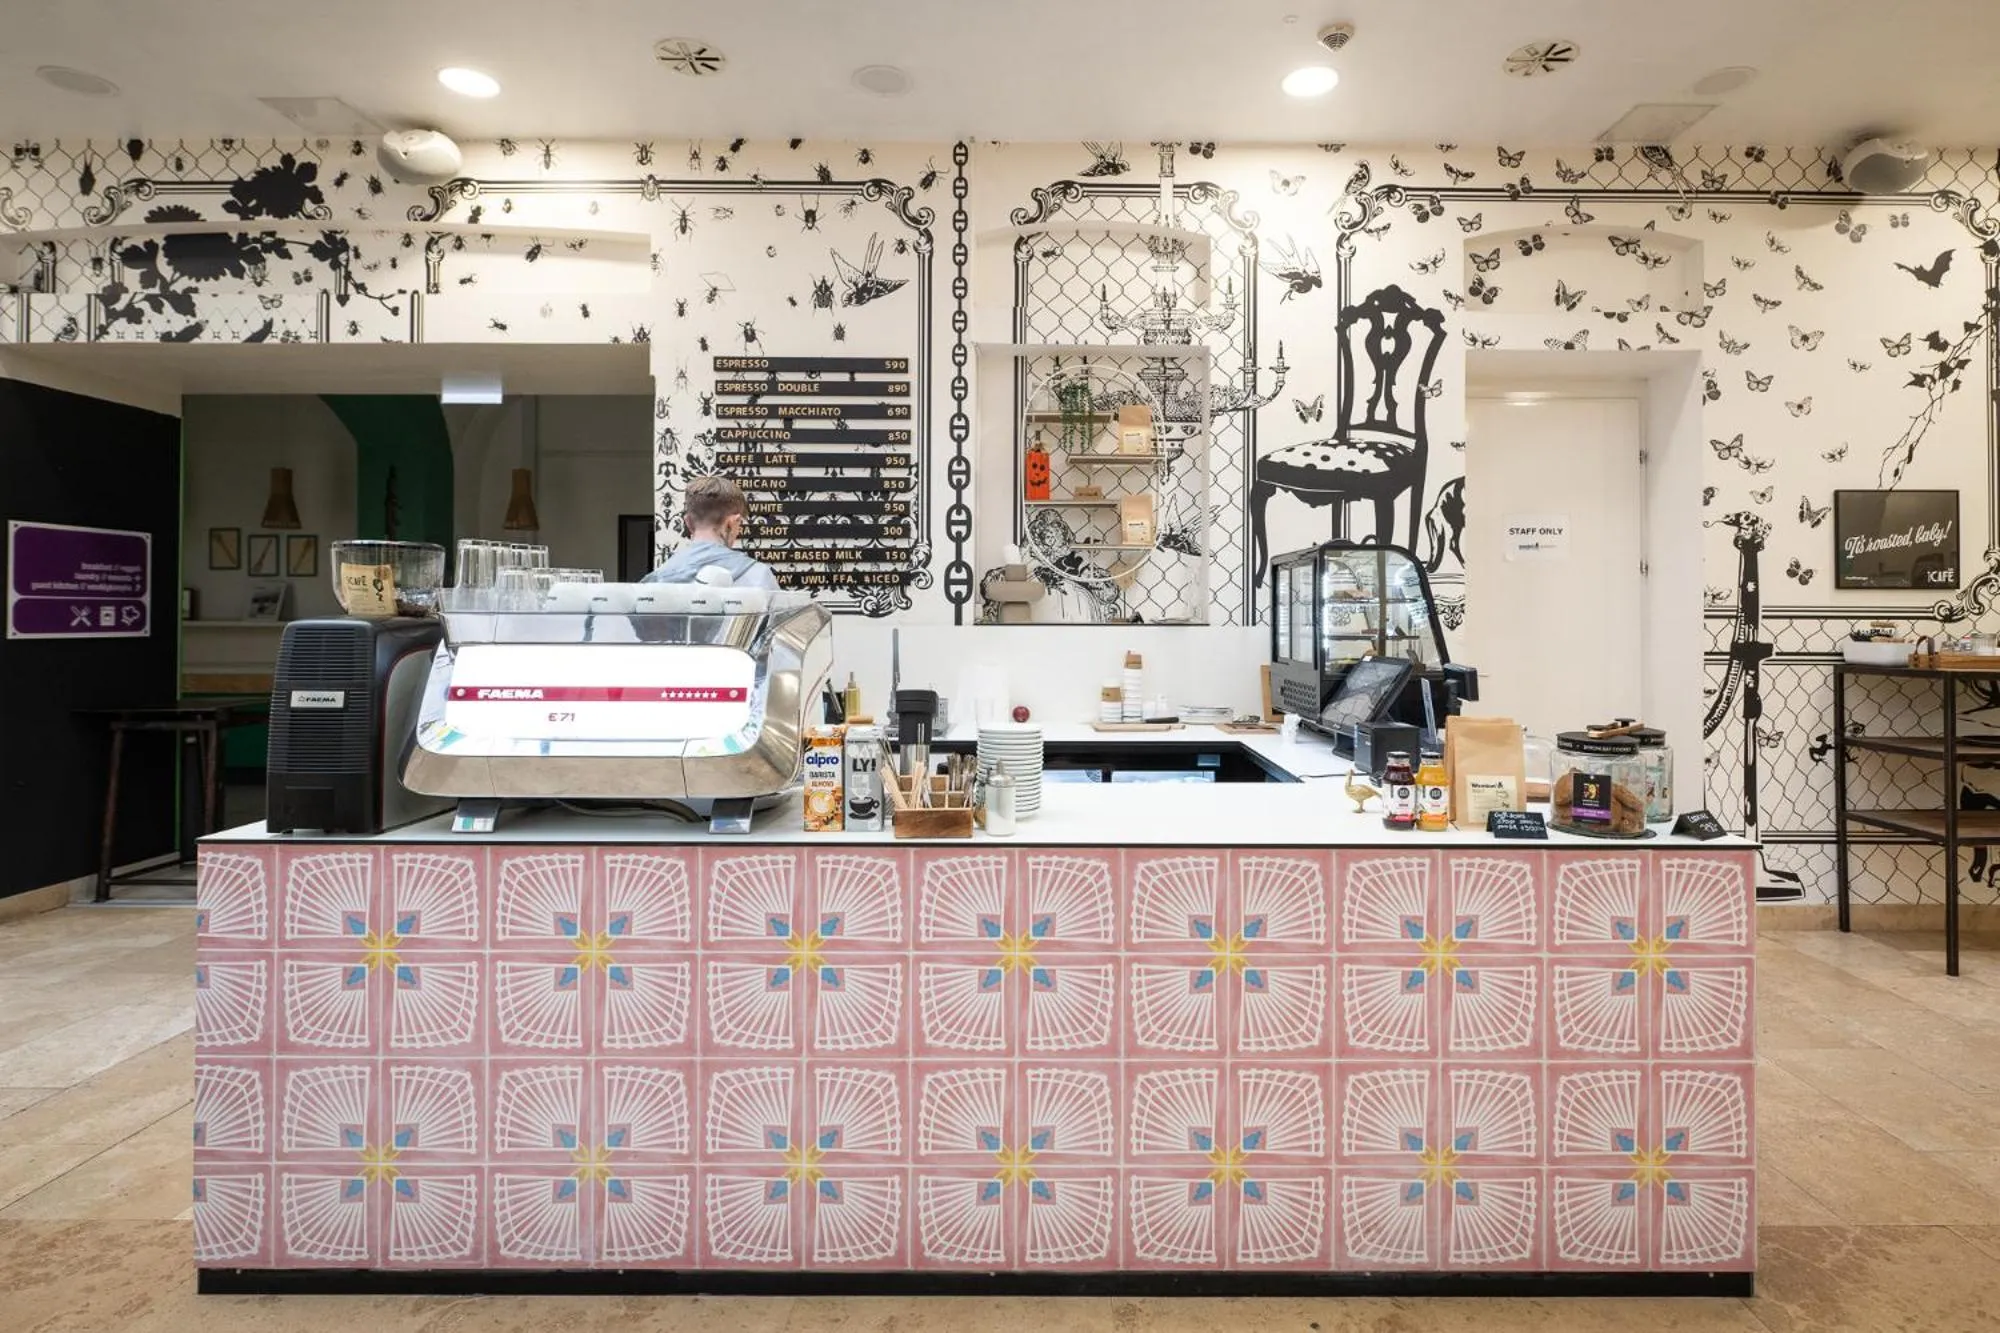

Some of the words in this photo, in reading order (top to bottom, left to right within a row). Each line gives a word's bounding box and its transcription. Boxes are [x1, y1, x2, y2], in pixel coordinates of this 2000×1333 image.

[716, 359, 769, 368] ESPRESSO
[885, 361, 906, 369] 590
[717, 383, 768, 392] ESPRESSO
[778, 383, 820, 392] DOUBLE
[887, 384, 907, 393] 890
[718, 407, 768, 416] ESPRESSO
[778, 407, 841, 416] MACCHIATO
[887, 407, 908, 416] 690
[720, 430, 791, 439] CAPPUCCINO
[888, 432, 908, 441] 850
[719, 455, 754, 464] CAFFE
[765, 455, 797, 464] LATTE
[885, 457, 905, 466] 950
[732, 480, 787, 489] ERICANO
[883, 480, 905, 489] 850
[749, 503, 783, 512] WHITE
[884, 503, 905, 512] 950
[760, 527, 789, 536] SHOT
[883, 527, 903, 536] 300
[1509, 527, 1537, 535] STAFF
[1539, 527, 1563, 535] ONLY
[1866, 527, 1913, 552] roasted,
[1915, 520, 1952, 547] baby!
[835, 551, 862, 560] MILK
[885, 551, 907, 560] 150
[873, 574, 900, 583] ICED
[477, 688, 544, 699] FAEMA
[806, 752, 839, 768] alpro
[852, 758, 876, 772] LY!
